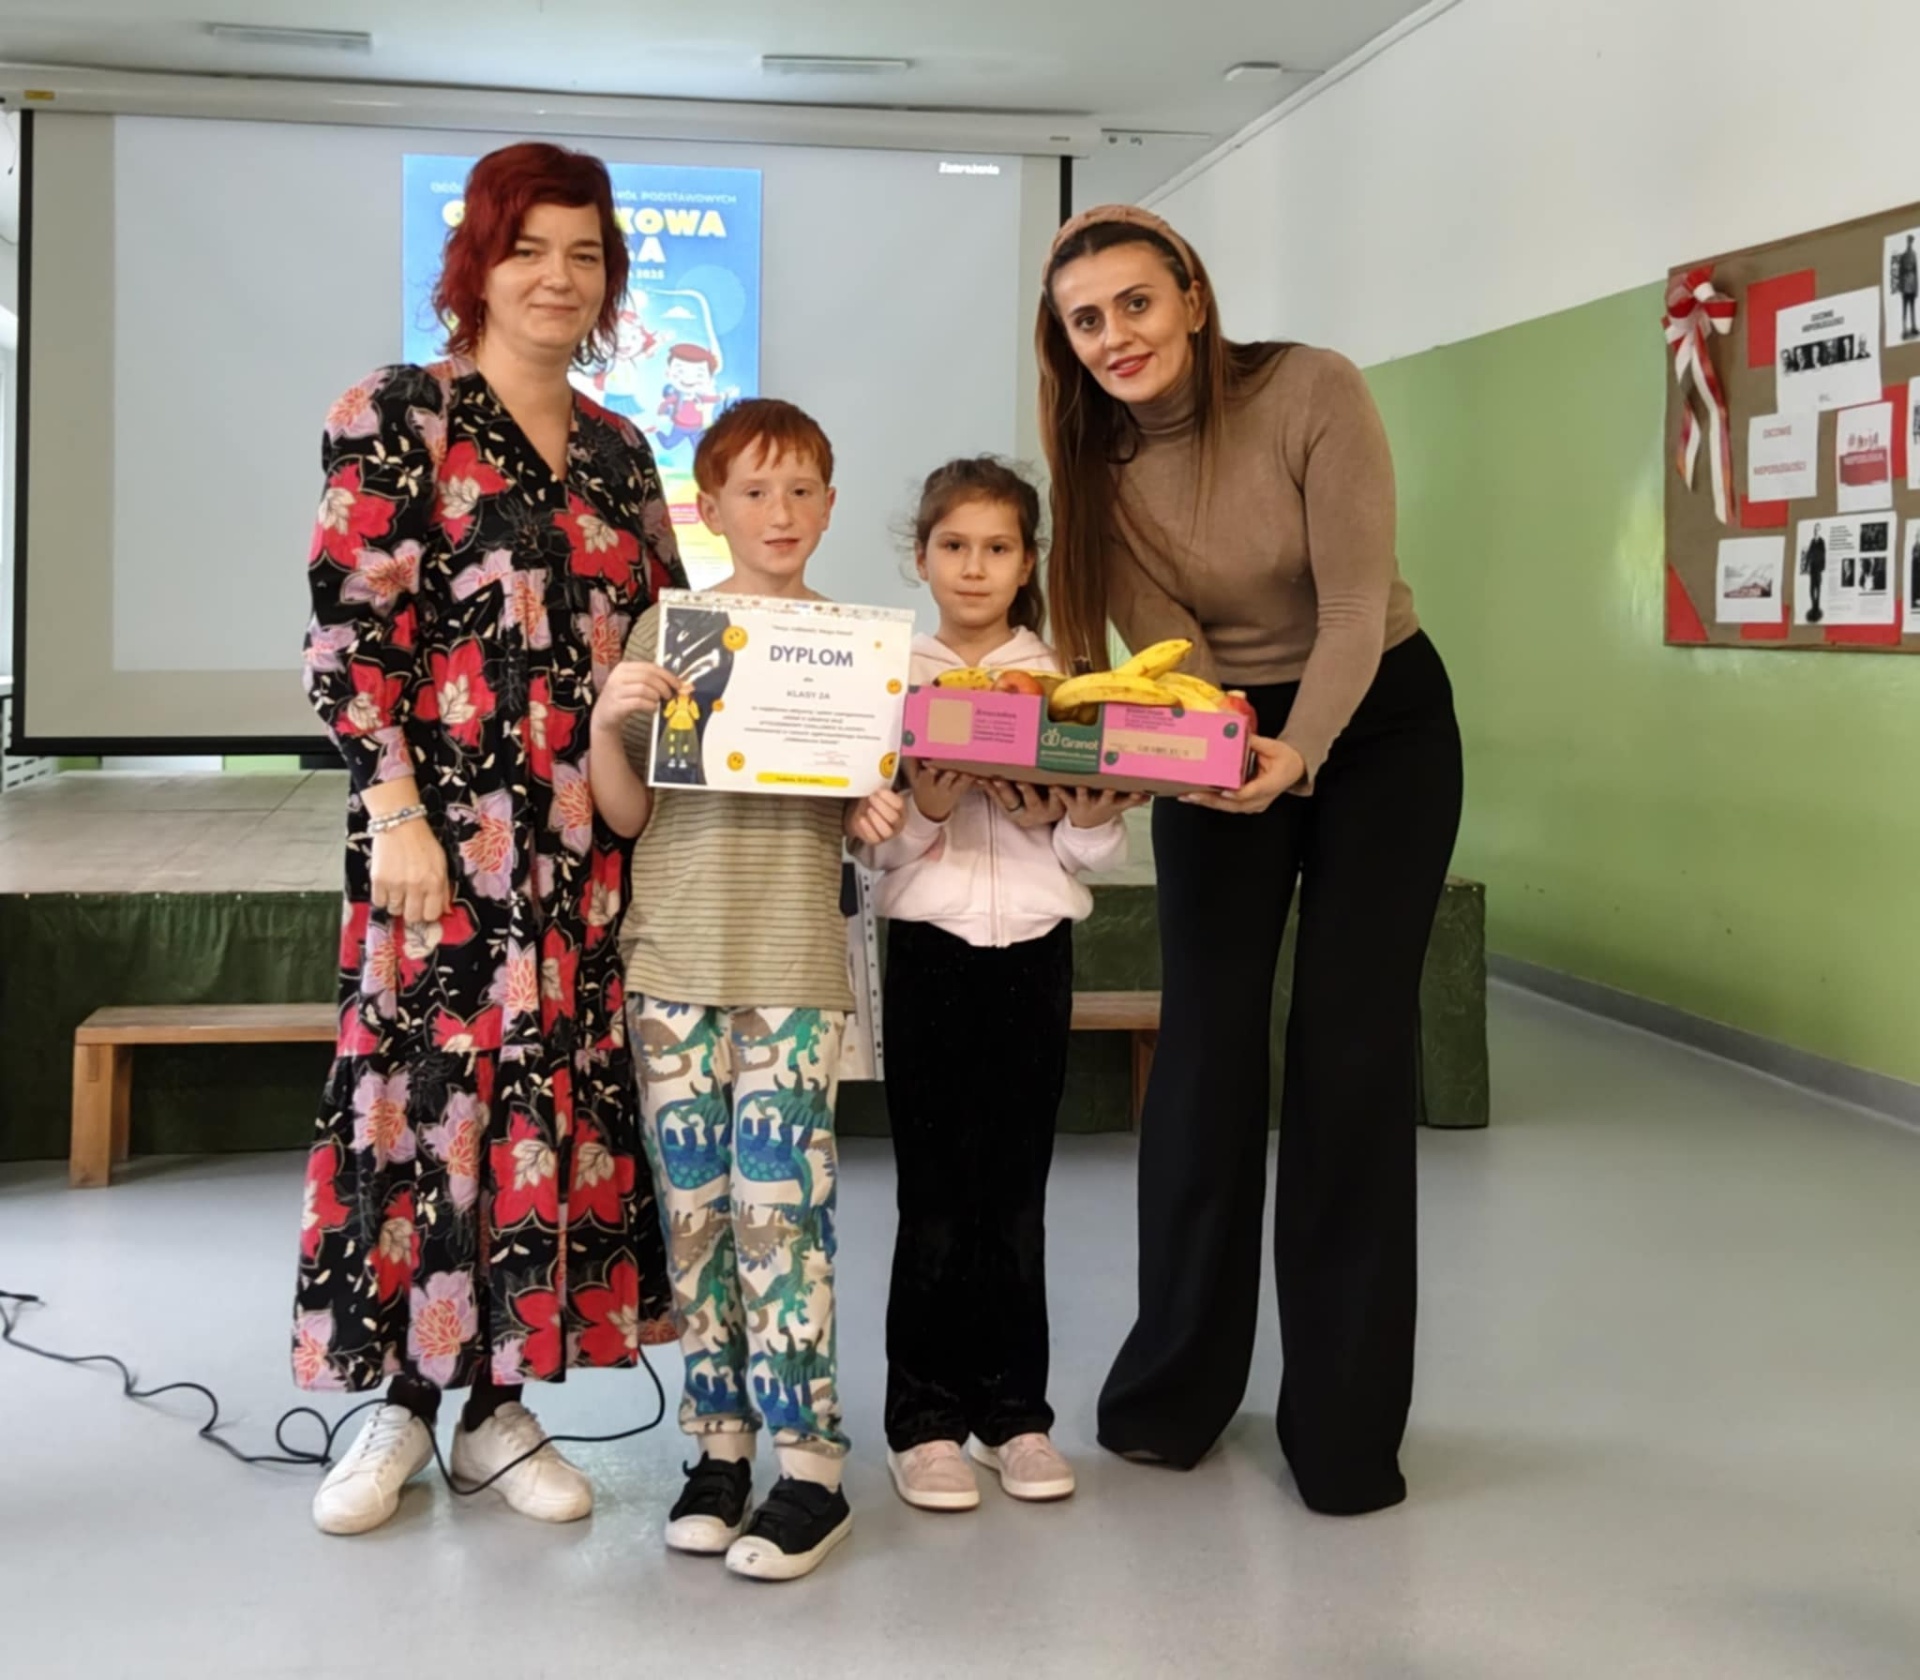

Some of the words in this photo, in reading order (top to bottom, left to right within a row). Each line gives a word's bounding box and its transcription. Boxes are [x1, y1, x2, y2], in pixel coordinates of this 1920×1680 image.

[641, 191, 737, 205] PODSTAWOWYCH
[769, 644, 854, 668] DYPLOM
[786, 689, 816, 700] KLASY
